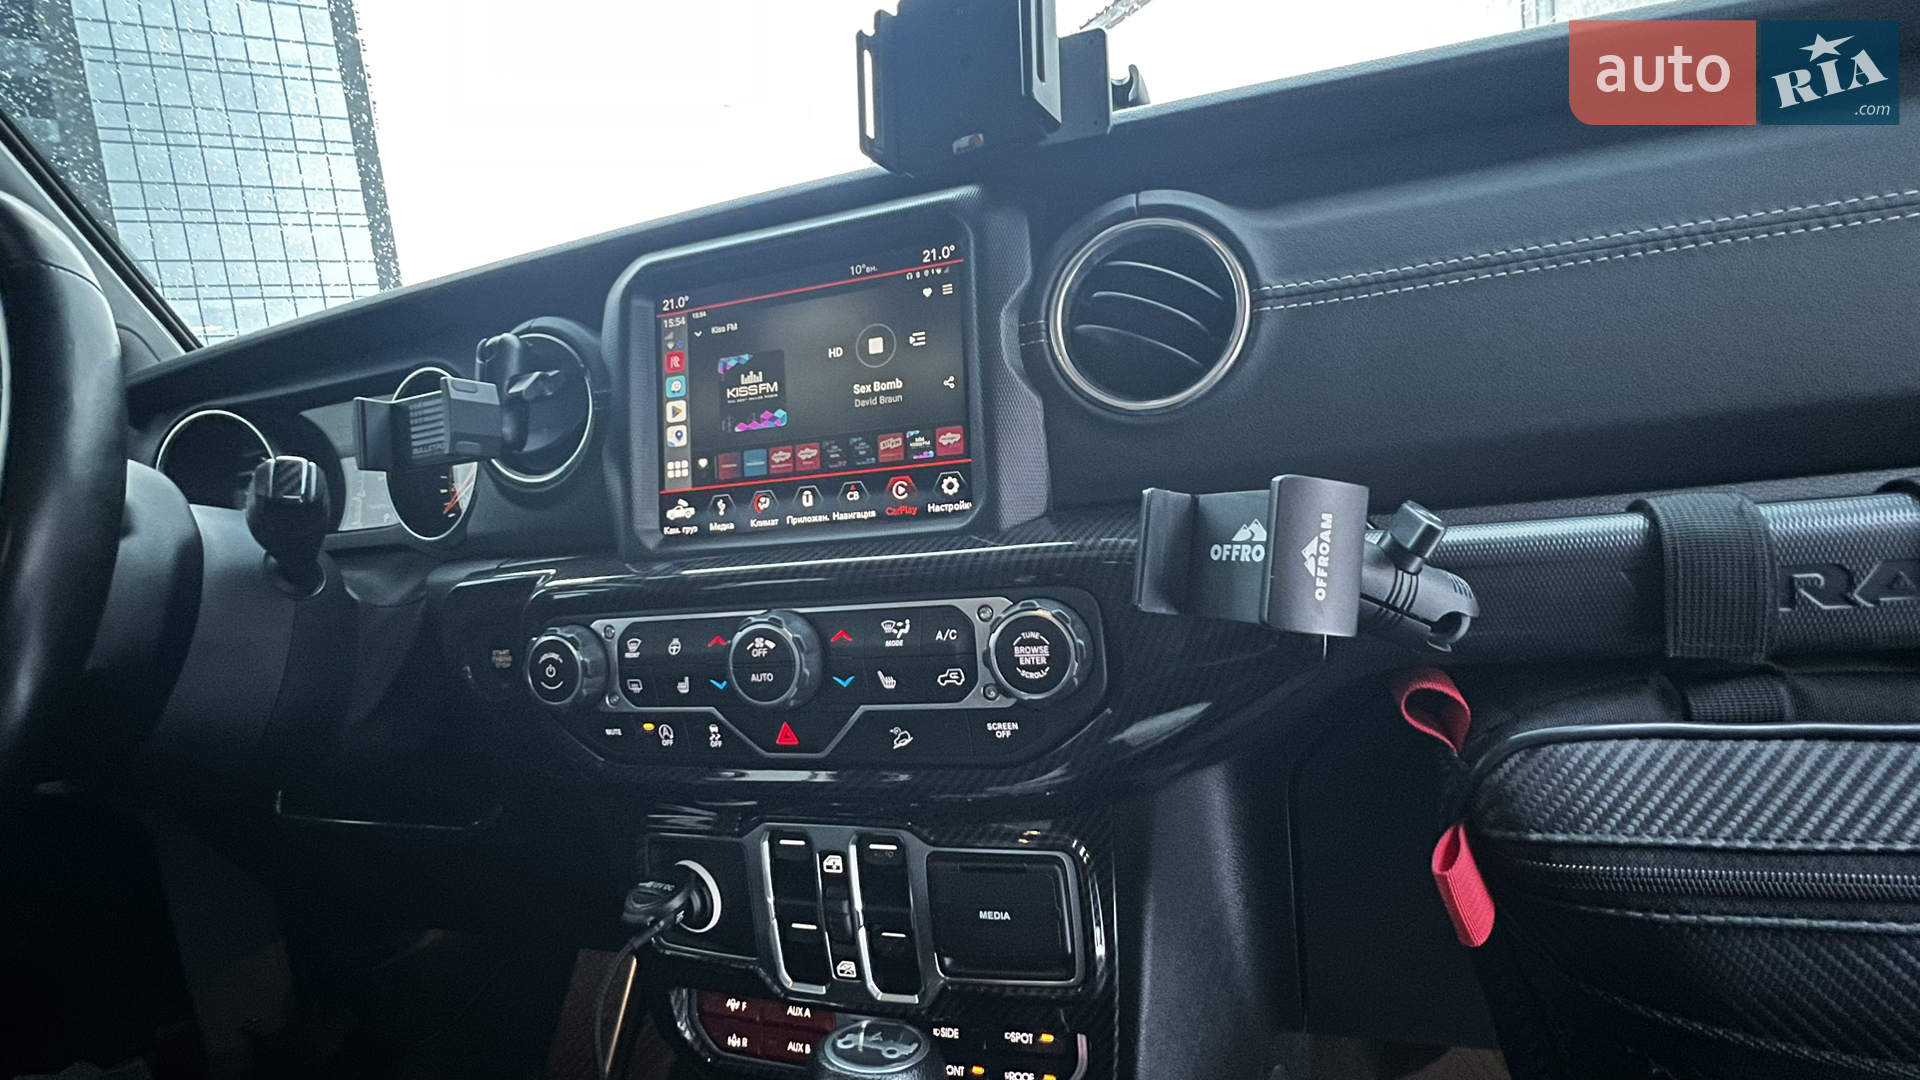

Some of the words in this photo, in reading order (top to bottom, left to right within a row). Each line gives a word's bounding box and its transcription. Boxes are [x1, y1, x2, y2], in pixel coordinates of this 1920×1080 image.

[663, 316, 686, 329] 15:54
[828, 346, 844, 359] HD
[727, 385, 758, 398] KISS
[758, 382, 778, 394] FM
[852, 383, 873, 395] Sex
[872, 377, 904, 393] Bomb
[854, 396, 878, 408] David
[878, 394, 903, 405] Braun
[832, 510, 876, 521] Навигация
[885, 505, 918, 517] CarPlay
[1315, 513, 1333, 601] OFFROAM
[935, 629, 958, 642] A/C
[1021, 631, 1041, 641] TUNE
[751, 648, 768, 658] OFF
[1014, 644, 1050, 656] BROWSE
[1019, 656, 1047, 667] ENTER
[750, 672, 774, 683] AUTO
[986, 722, 1019, 731] SCREEN
[995, 730, 1012, 739] OFF
[661, 739, 674, 747] OFF
[709, 740, 723, 748] OFF
[979, 911, 1011, 921] MEDIA
[787, 1006, 803, 1017] AUX
[804, 1007, 811, 1018] A
[940, 1027, 959, 1039] SIDE
[1011, 1032, 1033, 1044] SPOT
[787, 1042, 803, 1052] AUX
[804, 1044, 811, 1054] B
